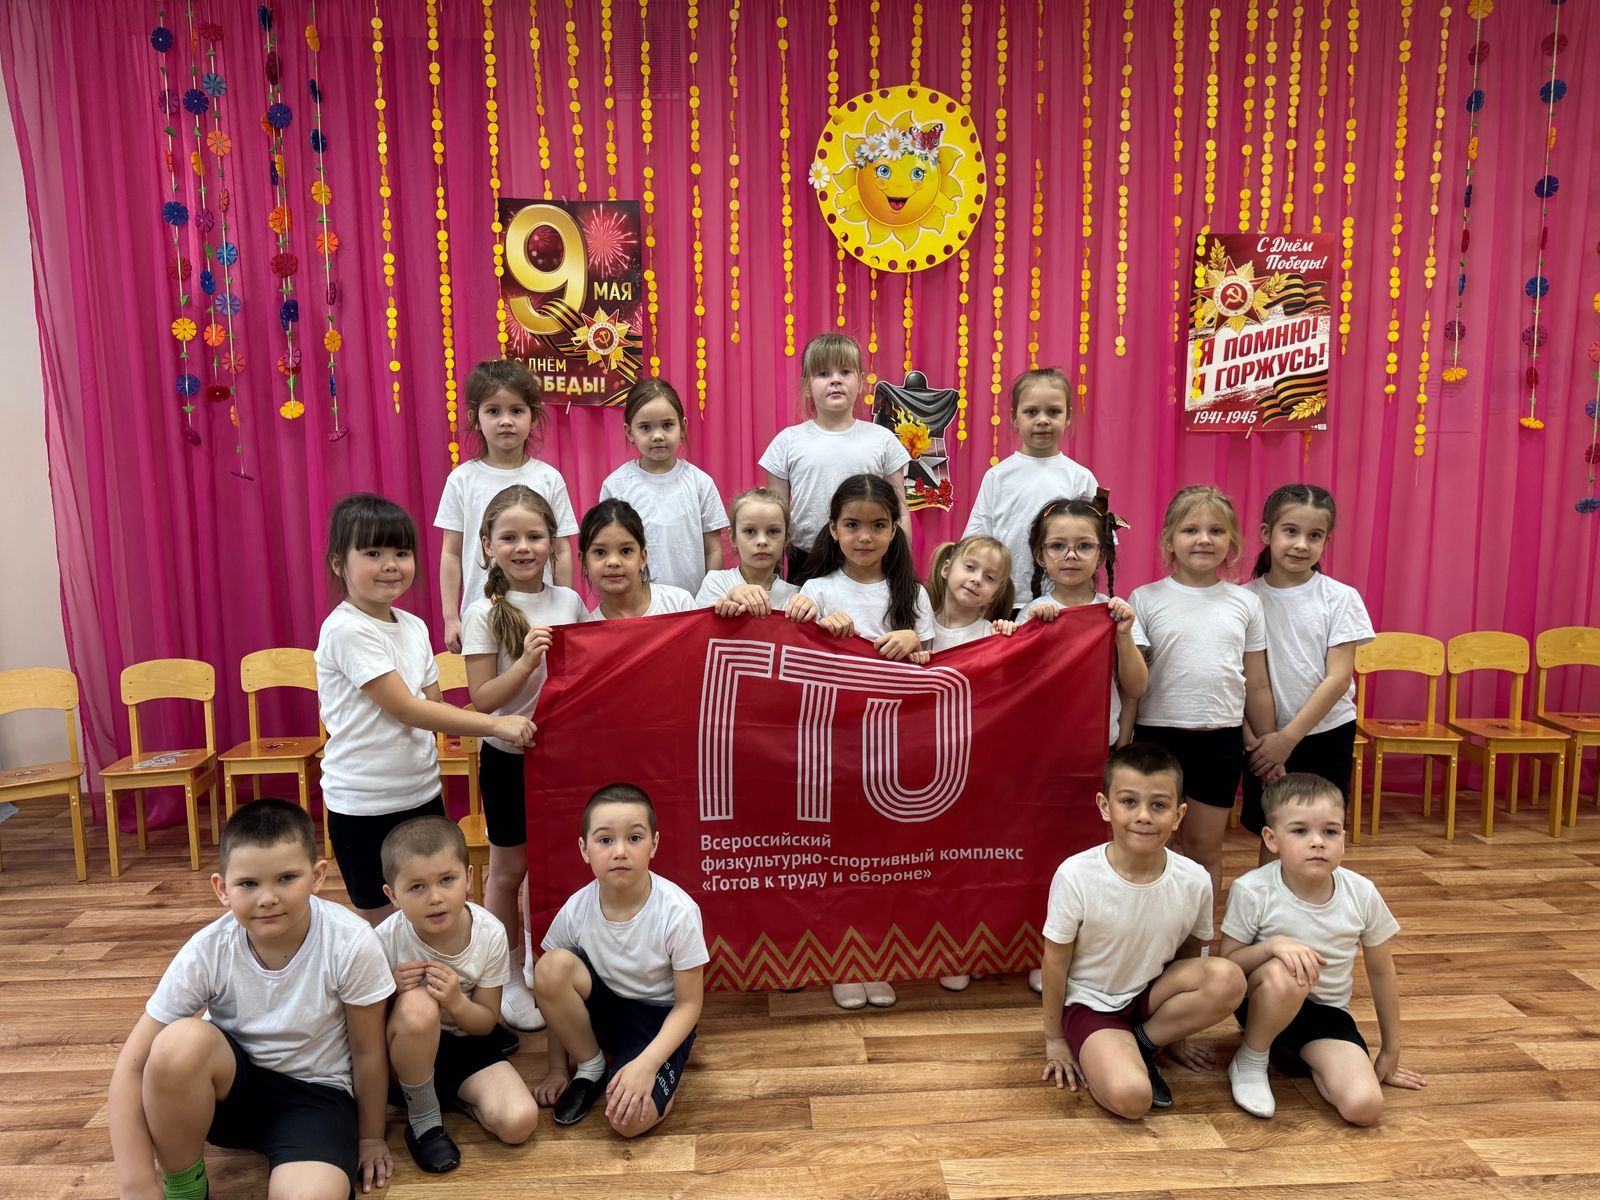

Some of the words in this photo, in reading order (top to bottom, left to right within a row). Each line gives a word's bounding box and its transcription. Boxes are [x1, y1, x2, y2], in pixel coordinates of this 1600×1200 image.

[1256, 236, 1270, 253] С
[1269, 236, 1314, 253] Днём
[505, 203, 588, 336] 9
[593, 281, 632, 301] МАЯ
[1266, 254, 1328, 274] Победы!
[1198, 337, 1216, 369] Я
[1223, 317, 1319, 362] ПОМНЮ!
[528, 356, 567, 373] ДНЁМ
[1215, 342, 1326, 392] ГОРЖУСЬ!
[1193, 410, 1259, 424] 1941-1945
[697, 638, 972, 823] ГТО
[700, 832, 831, 853] Всероссийский
[701, 848, 934, 875] физкультурно-спортивный
[940, 847, 1024, 860] комплекс
[702, 875, 760, 891] «Готов
[765, 876, 775, 888] к
[778, 872, 827, 890] труду
[833, 871, 843, 883] и
[849, 869, 932, 884] обороне»
